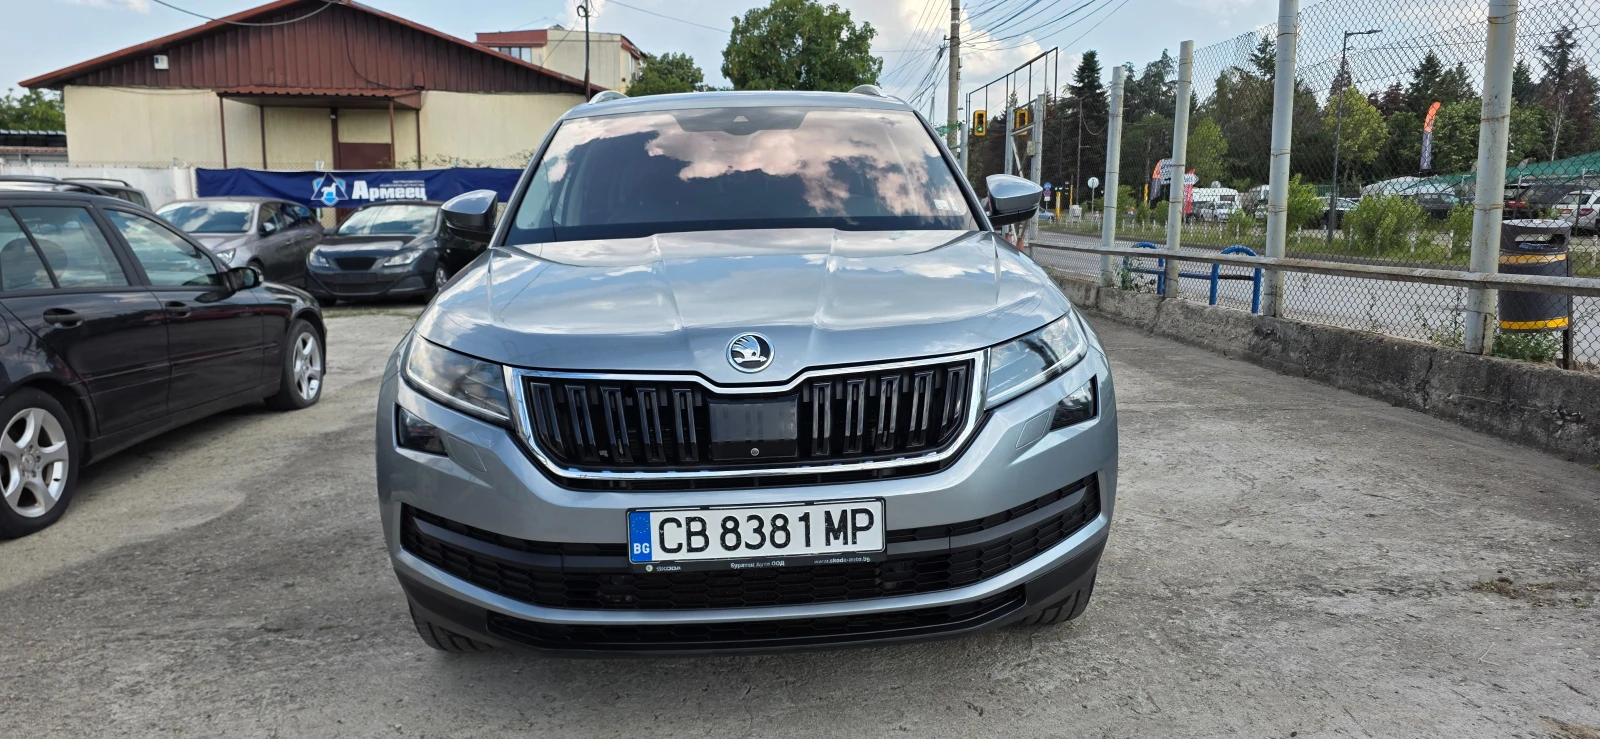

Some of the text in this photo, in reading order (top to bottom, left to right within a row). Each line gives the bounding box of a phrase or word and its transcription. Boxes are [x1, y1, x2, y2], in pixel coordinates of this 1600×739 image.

[351, 180, 427, 201] Армеец
[658, 508, 875, 553] CB 8381 MP
[633, 543, 650, 555] BG
